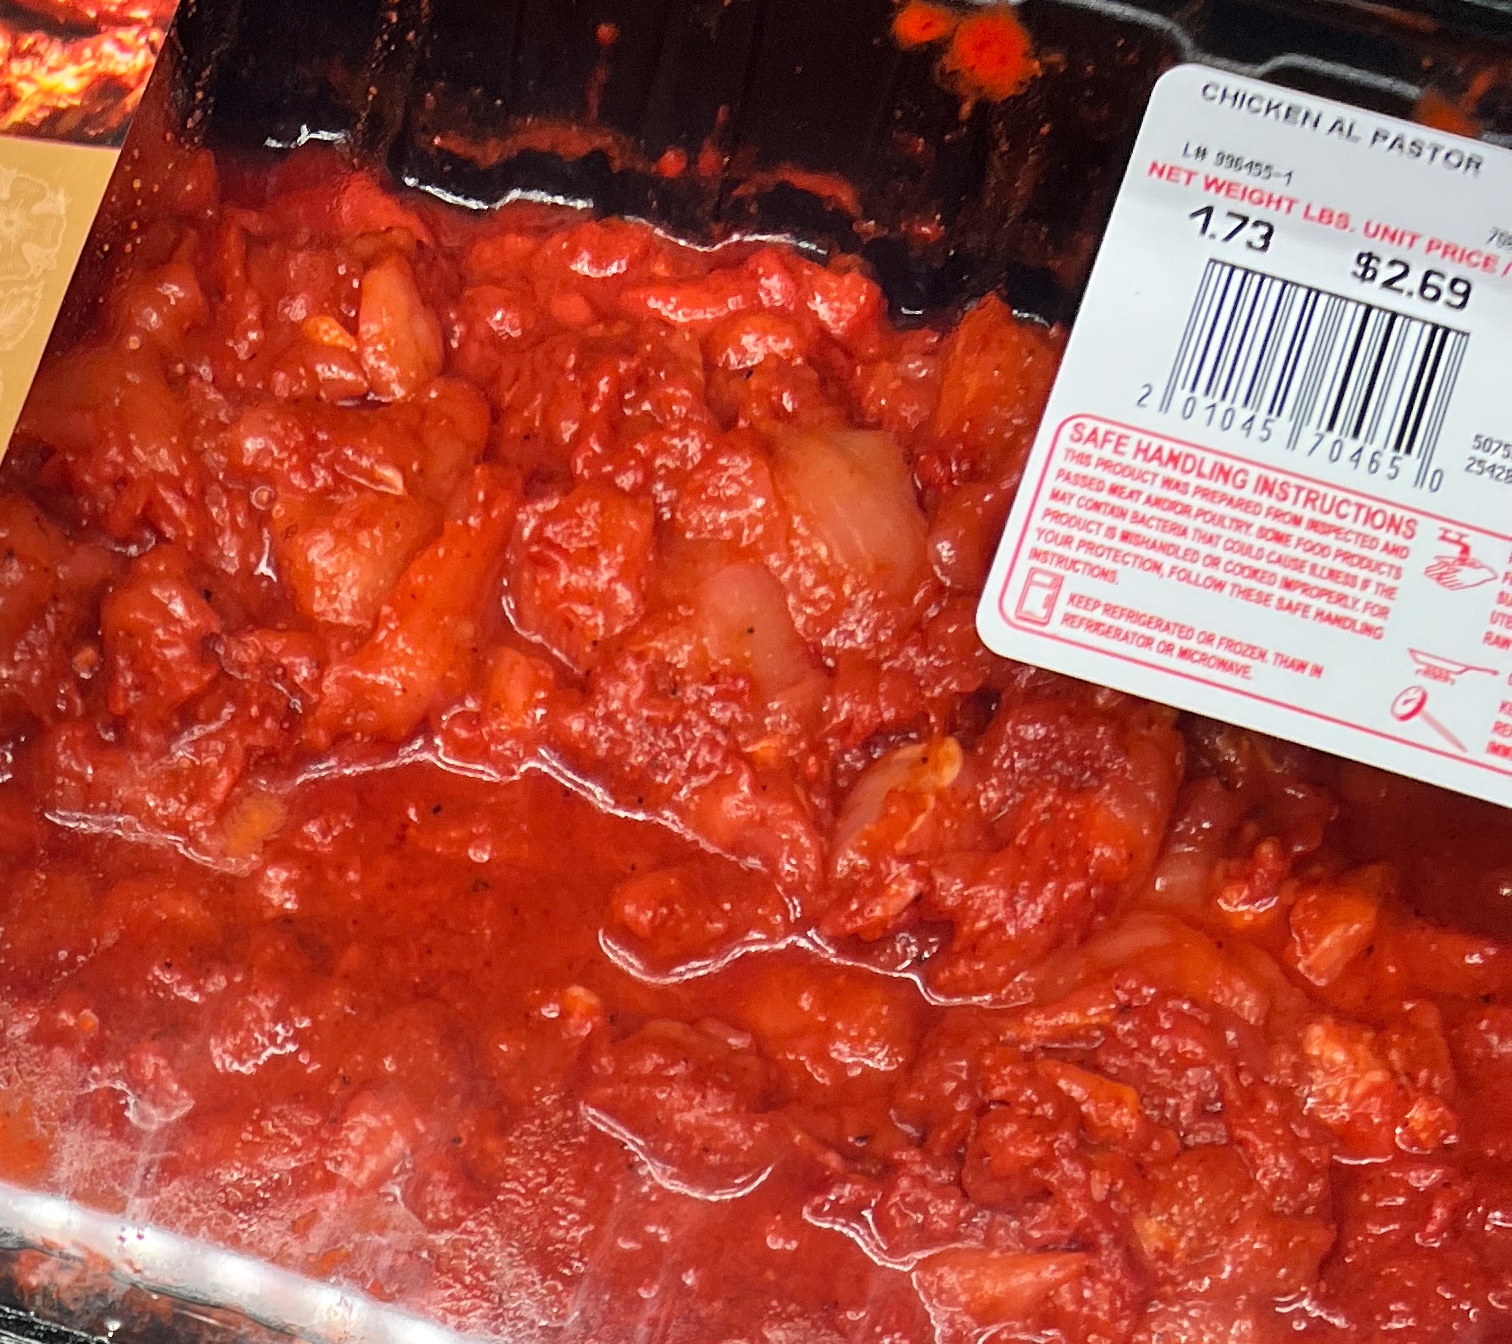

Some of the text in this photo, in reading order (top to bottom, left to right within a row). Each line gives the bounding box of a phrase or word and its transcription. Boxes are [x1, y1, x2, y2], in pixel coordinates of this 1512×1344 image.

[1201, 83, 1485, 178] CHICKEN AL PASTOR
[1148, 160, 1196, 185] NET
[1203, 174, 1297, 214] WEIGHT
[1302, 203, 1355, 233] LBS.
[1363, 220, 1420, 249] UNIT
[1424, 238, 1497, 270] PRICE
[1189, 204, 1274, 253] 1.73
[1351, 250, 1472, 310] $2.69
[1069, 421, 1417, 540] SAFE HANDLING INSTRUCTIONS
[1471, 433, 1512, 462] 5075
